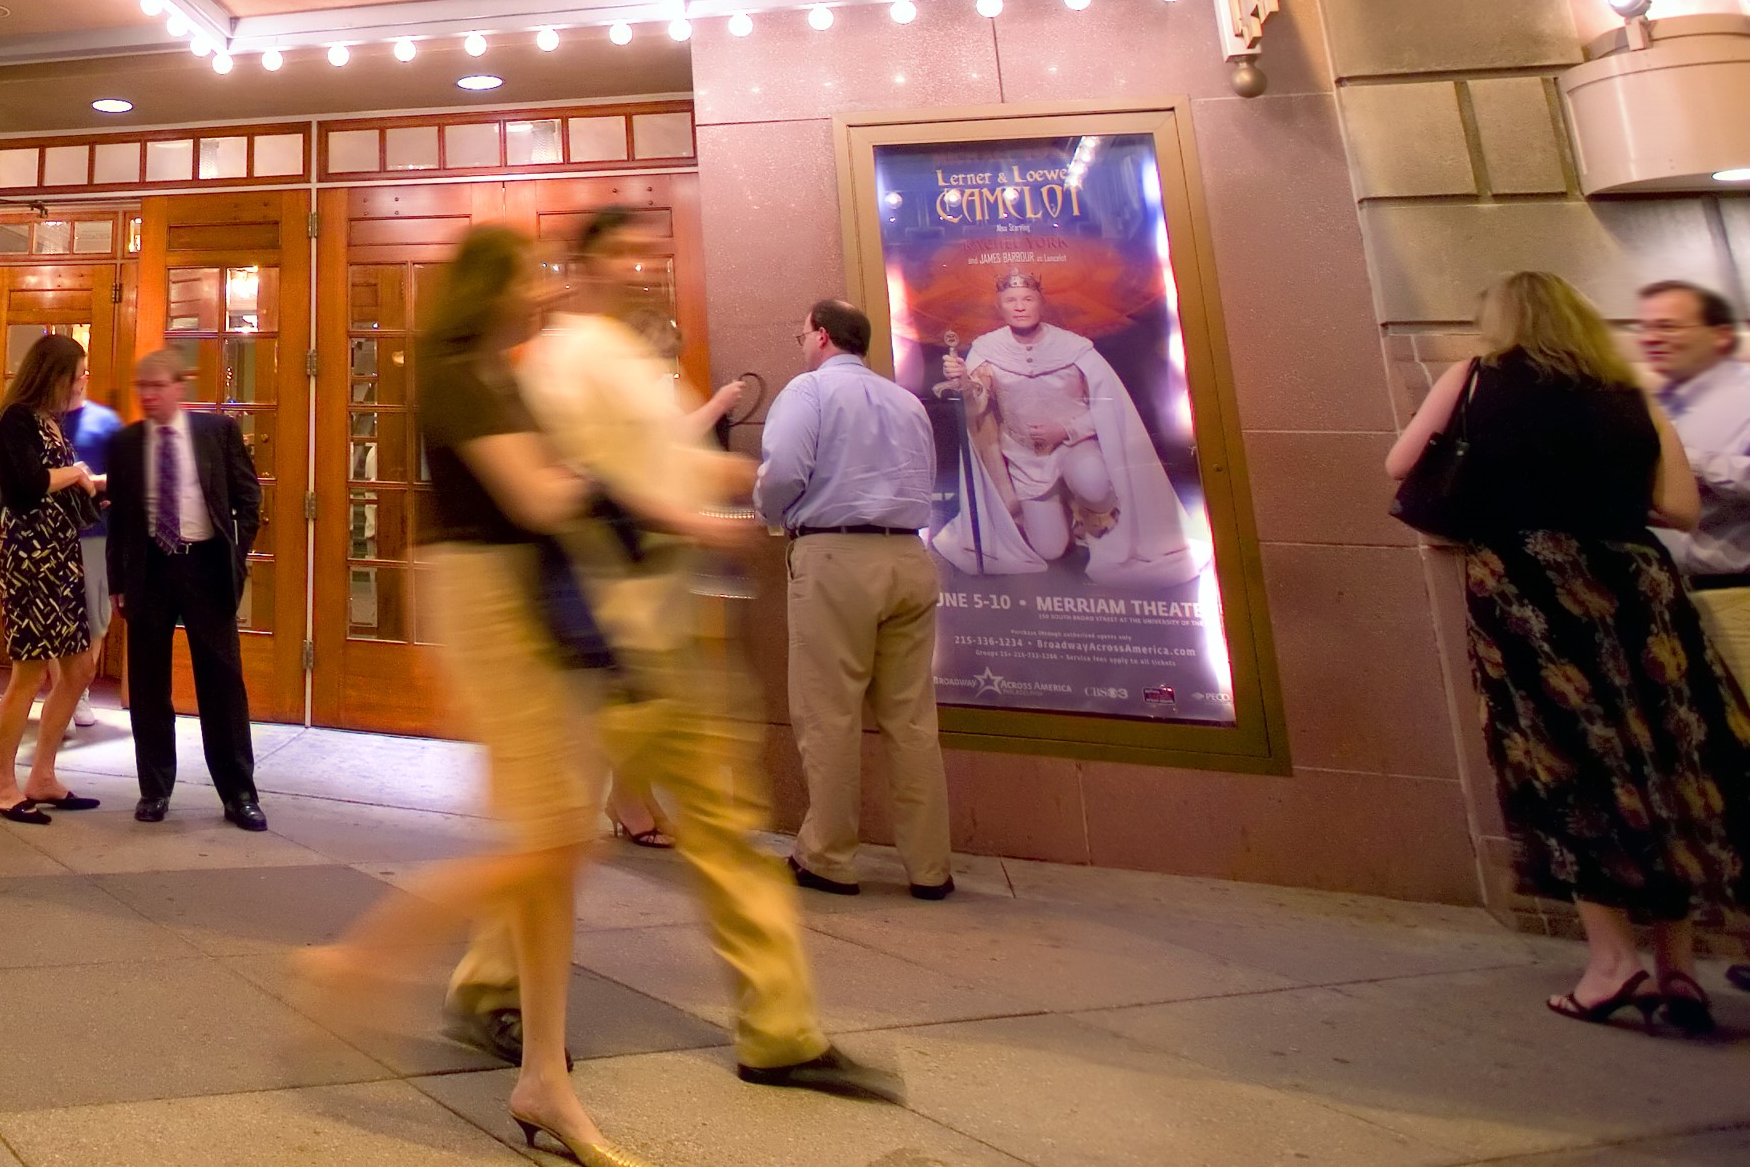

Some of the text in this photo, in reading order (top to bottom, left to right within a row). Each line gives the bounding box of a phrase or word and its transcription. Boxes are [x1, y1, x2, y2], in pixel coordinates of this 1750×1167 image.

[935, 165, 1068, 186] Lerner & Loewe
[936, 184, 1084, 224] CAMELOT
[1025, 236, 1069, 251] YORK
[979, 253, 1001, 264] JAMES
[1003, 252, 1035, 263] BARBOUR
[936, 592, 1203, 618] UNE 5-10 MERRIAM THEATE
[954, 635, 1196, 656] 215-336-1234 BroadwayAcrossAmerica.com
[933, 676, 1072, 693] BROADWAY ACROSS AMERICA
